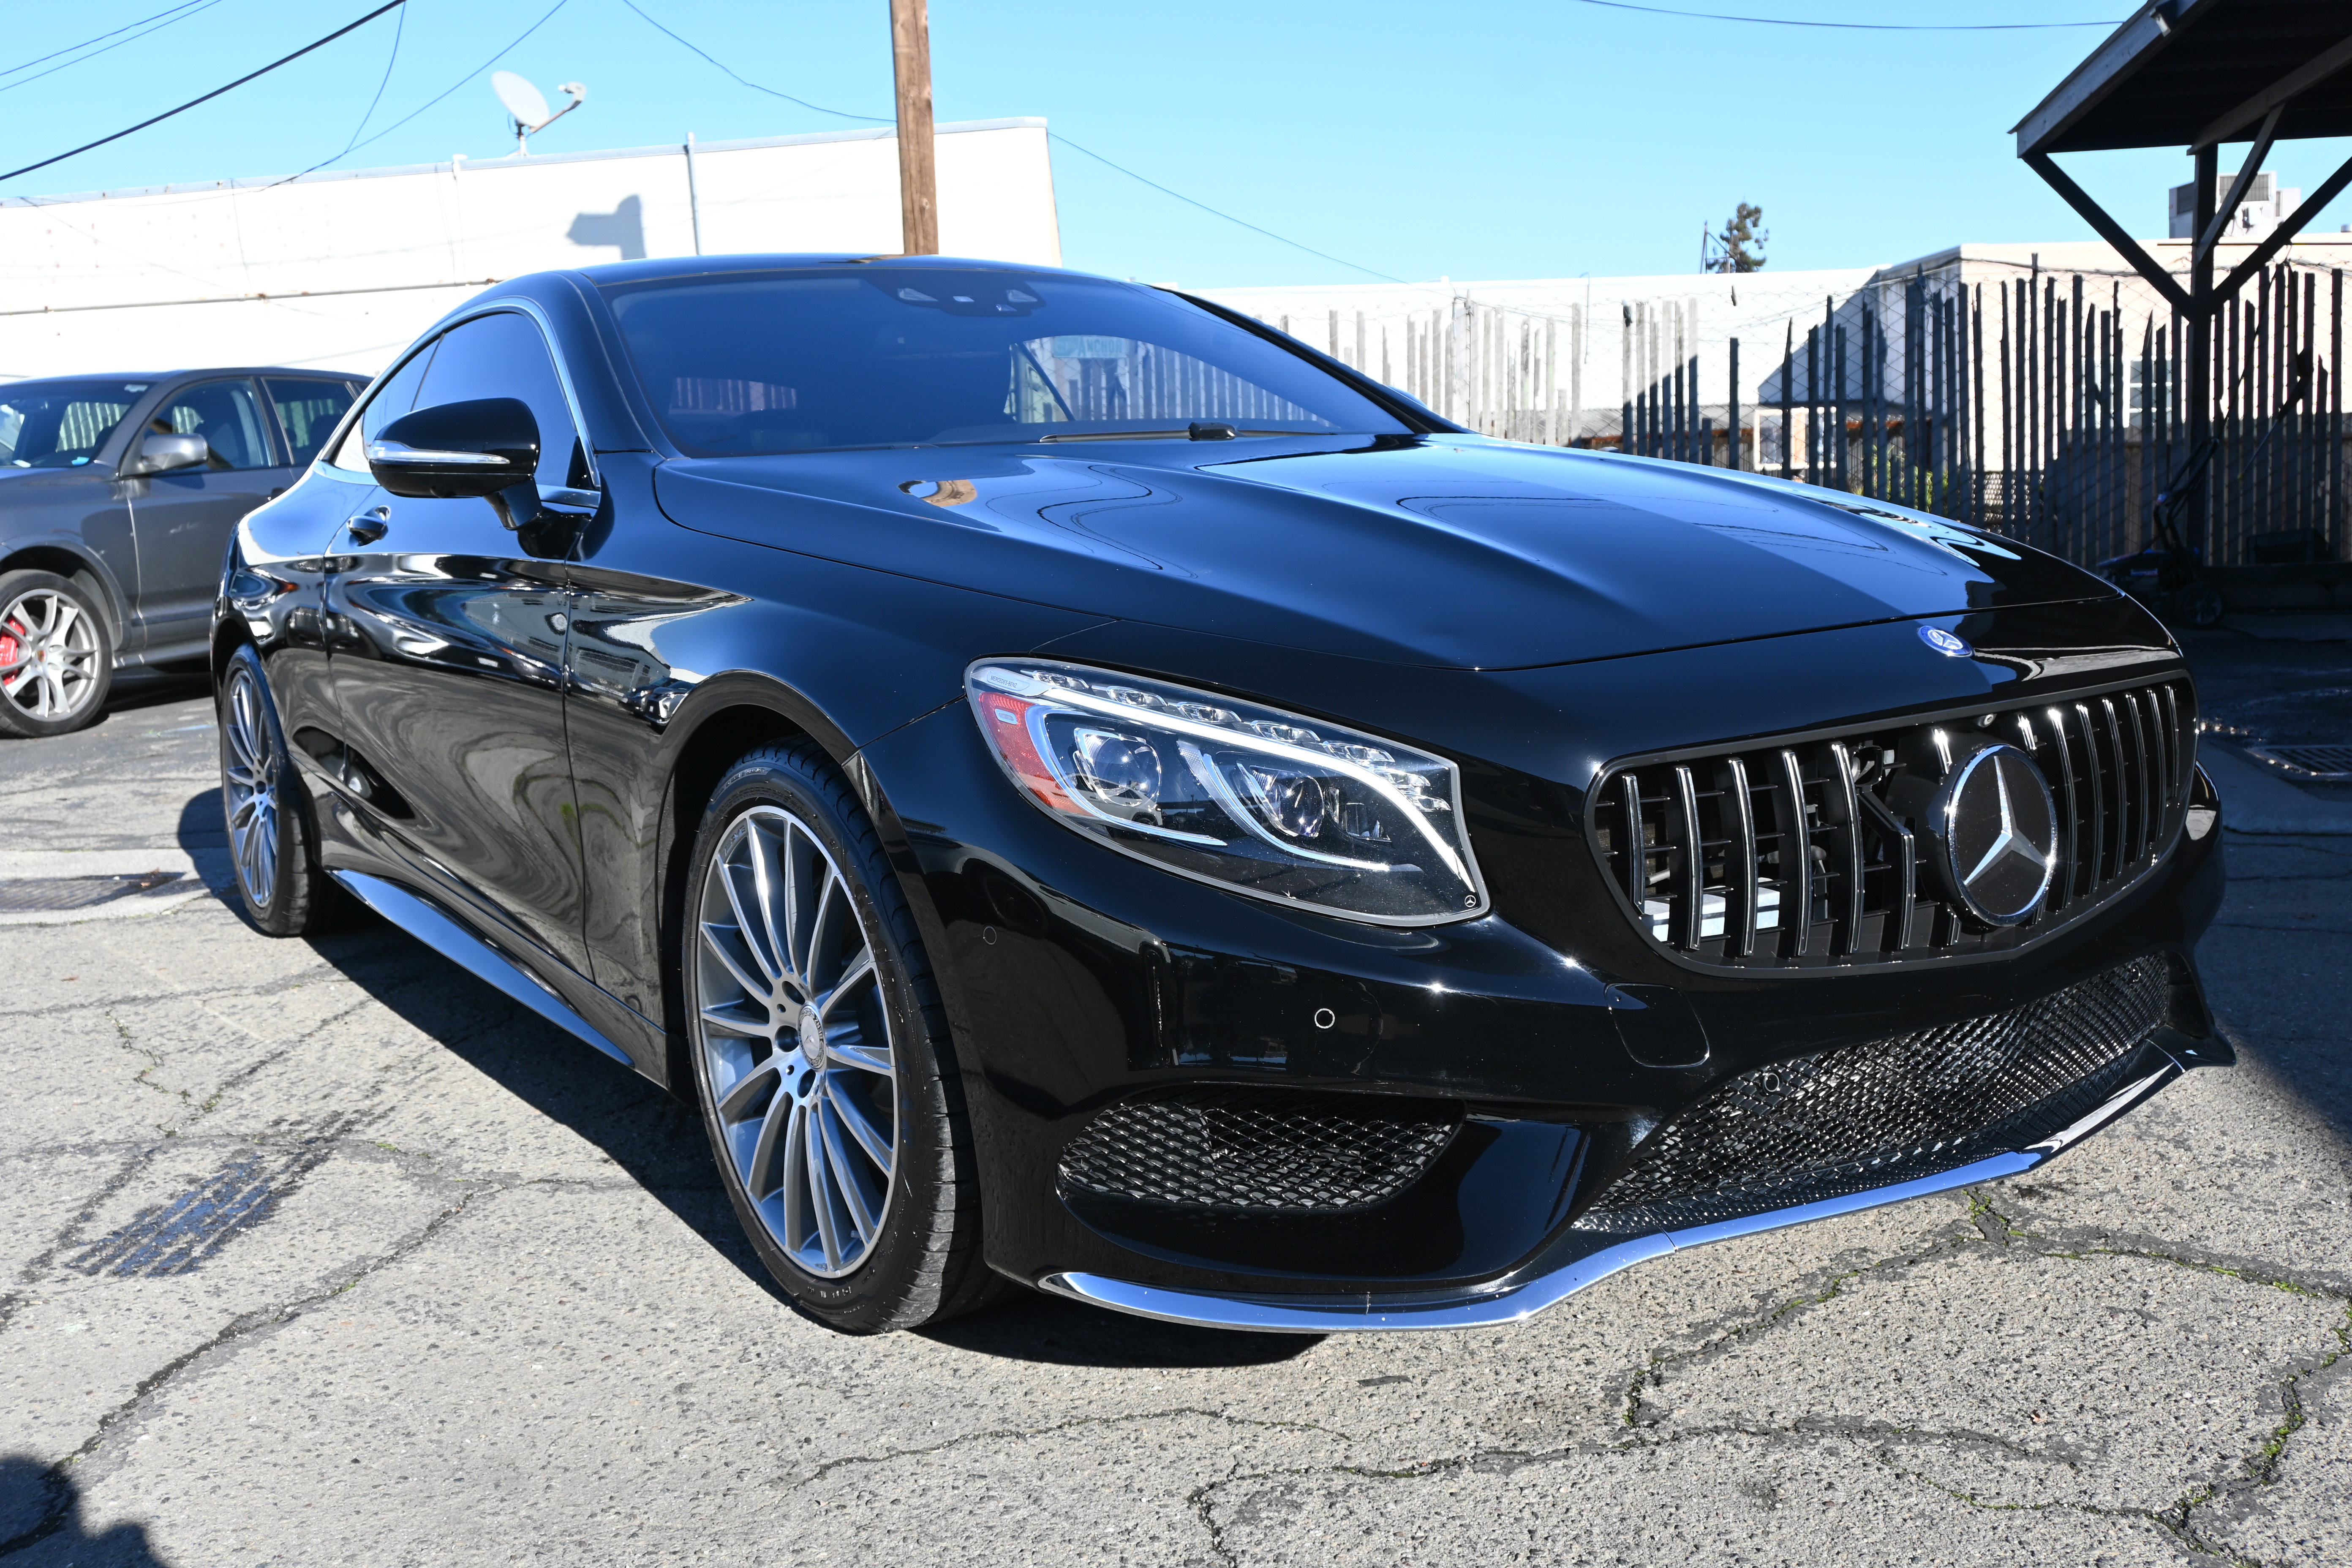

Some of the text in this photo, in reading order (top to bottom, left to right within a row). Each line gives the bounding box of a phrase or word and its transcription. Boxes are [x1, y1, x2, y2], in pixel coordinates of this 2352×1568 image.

[1078, 337, 1122, 356] ANCHOR
[990, 675, 1017, 688] MERCEDES-BENZ
[814, 1018, 823, 1039] BENZ
